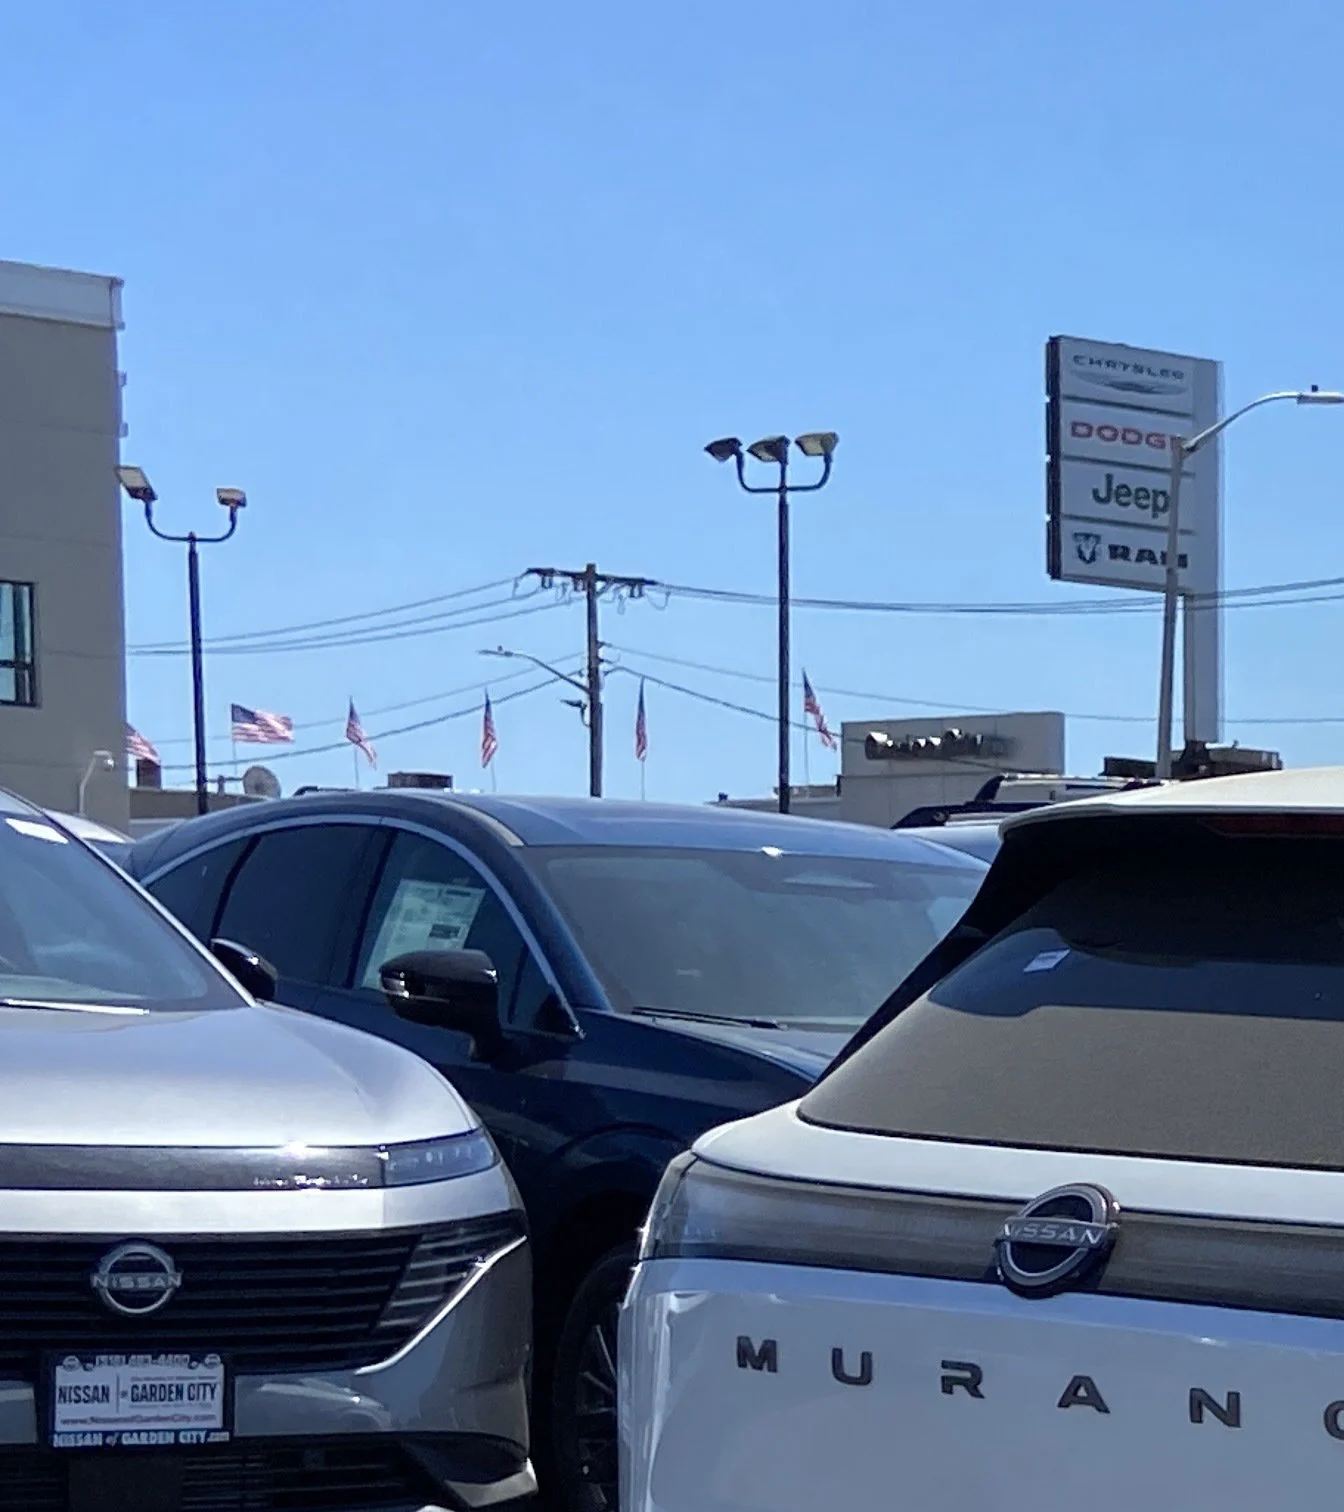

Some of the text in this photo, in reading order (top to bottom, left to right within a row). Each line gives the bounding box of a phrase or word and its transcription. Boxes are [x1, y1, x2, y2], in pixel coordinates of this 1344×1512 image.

[1072, 354, 1185, 380] CHRYSLER
[1091, 473, 1170, 518] Jeep
[1004, 1222, 1104, 1246] NISSAN
[92, 1273, 182, 1289] NISSAN
[57, 1384, 110, 1404] NISSAN
[130, 1383, 184, 1402] GARDEN
[187, 1382, 217, 1400] CITY
